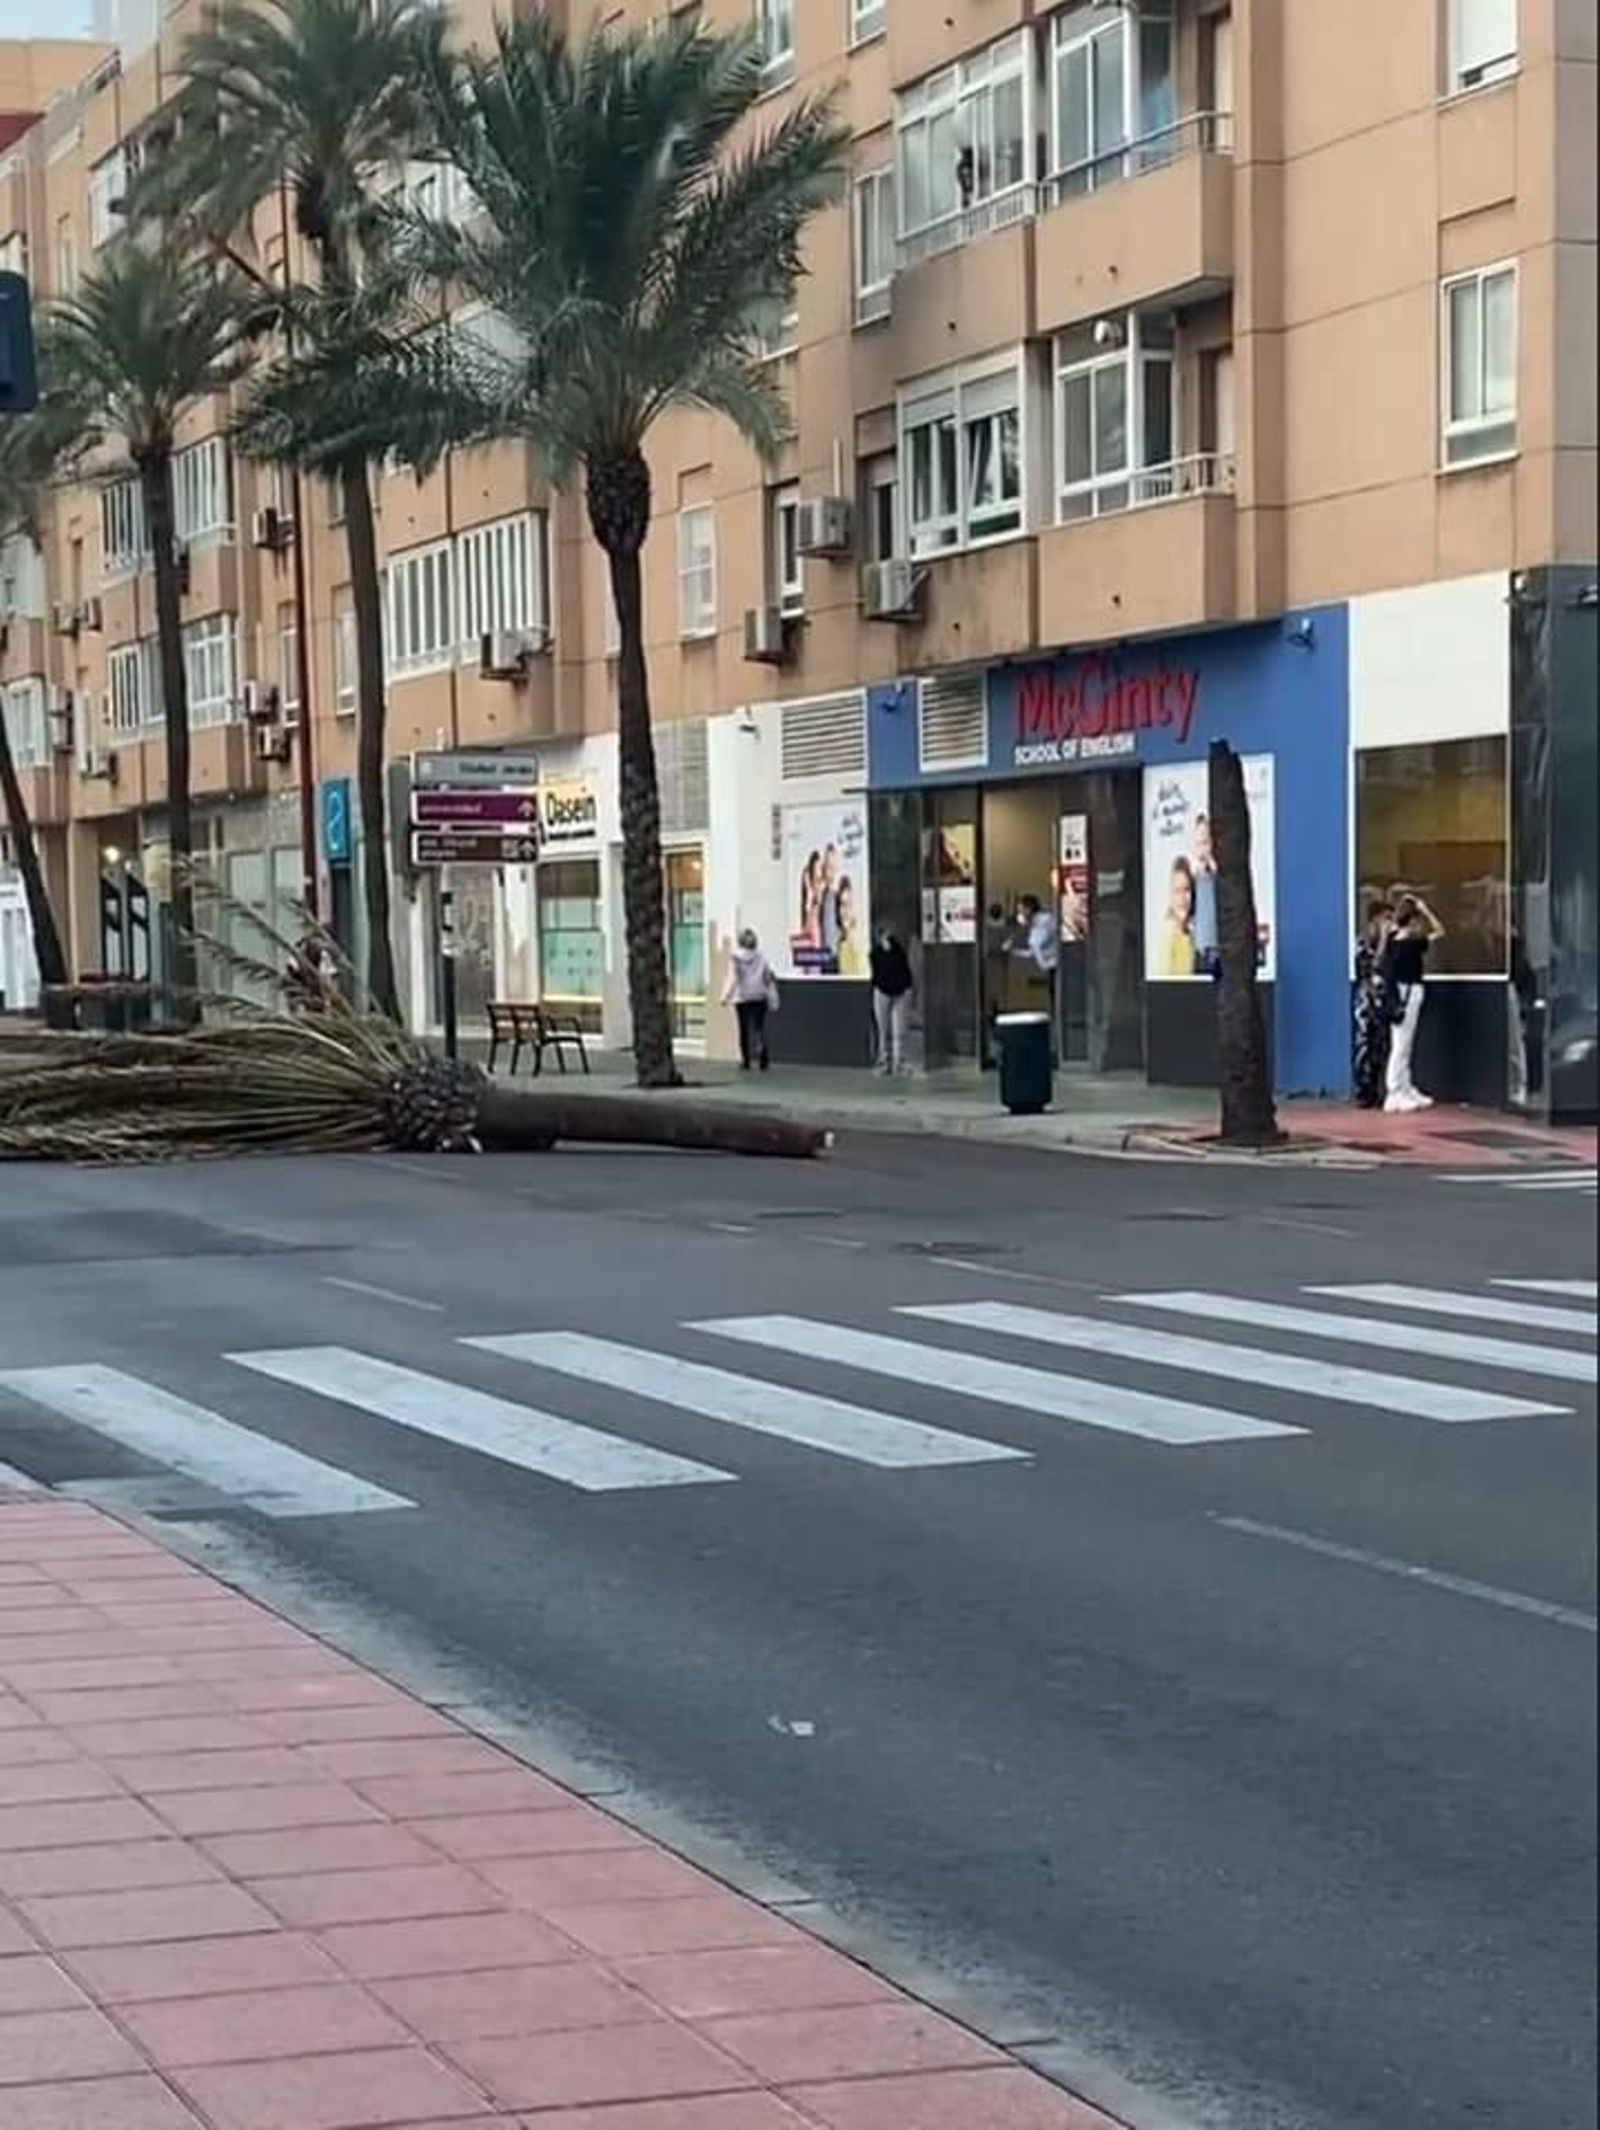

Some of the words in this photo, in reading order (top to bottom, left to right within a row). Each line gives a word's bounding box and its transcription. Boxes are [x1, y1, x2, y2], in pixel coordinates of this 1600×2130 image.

[1014, 740, 1061, 765] SCHOOL
[1062, 737, 1078, 760] OF
[1080, 732, 1135, 758] ENGLISH
